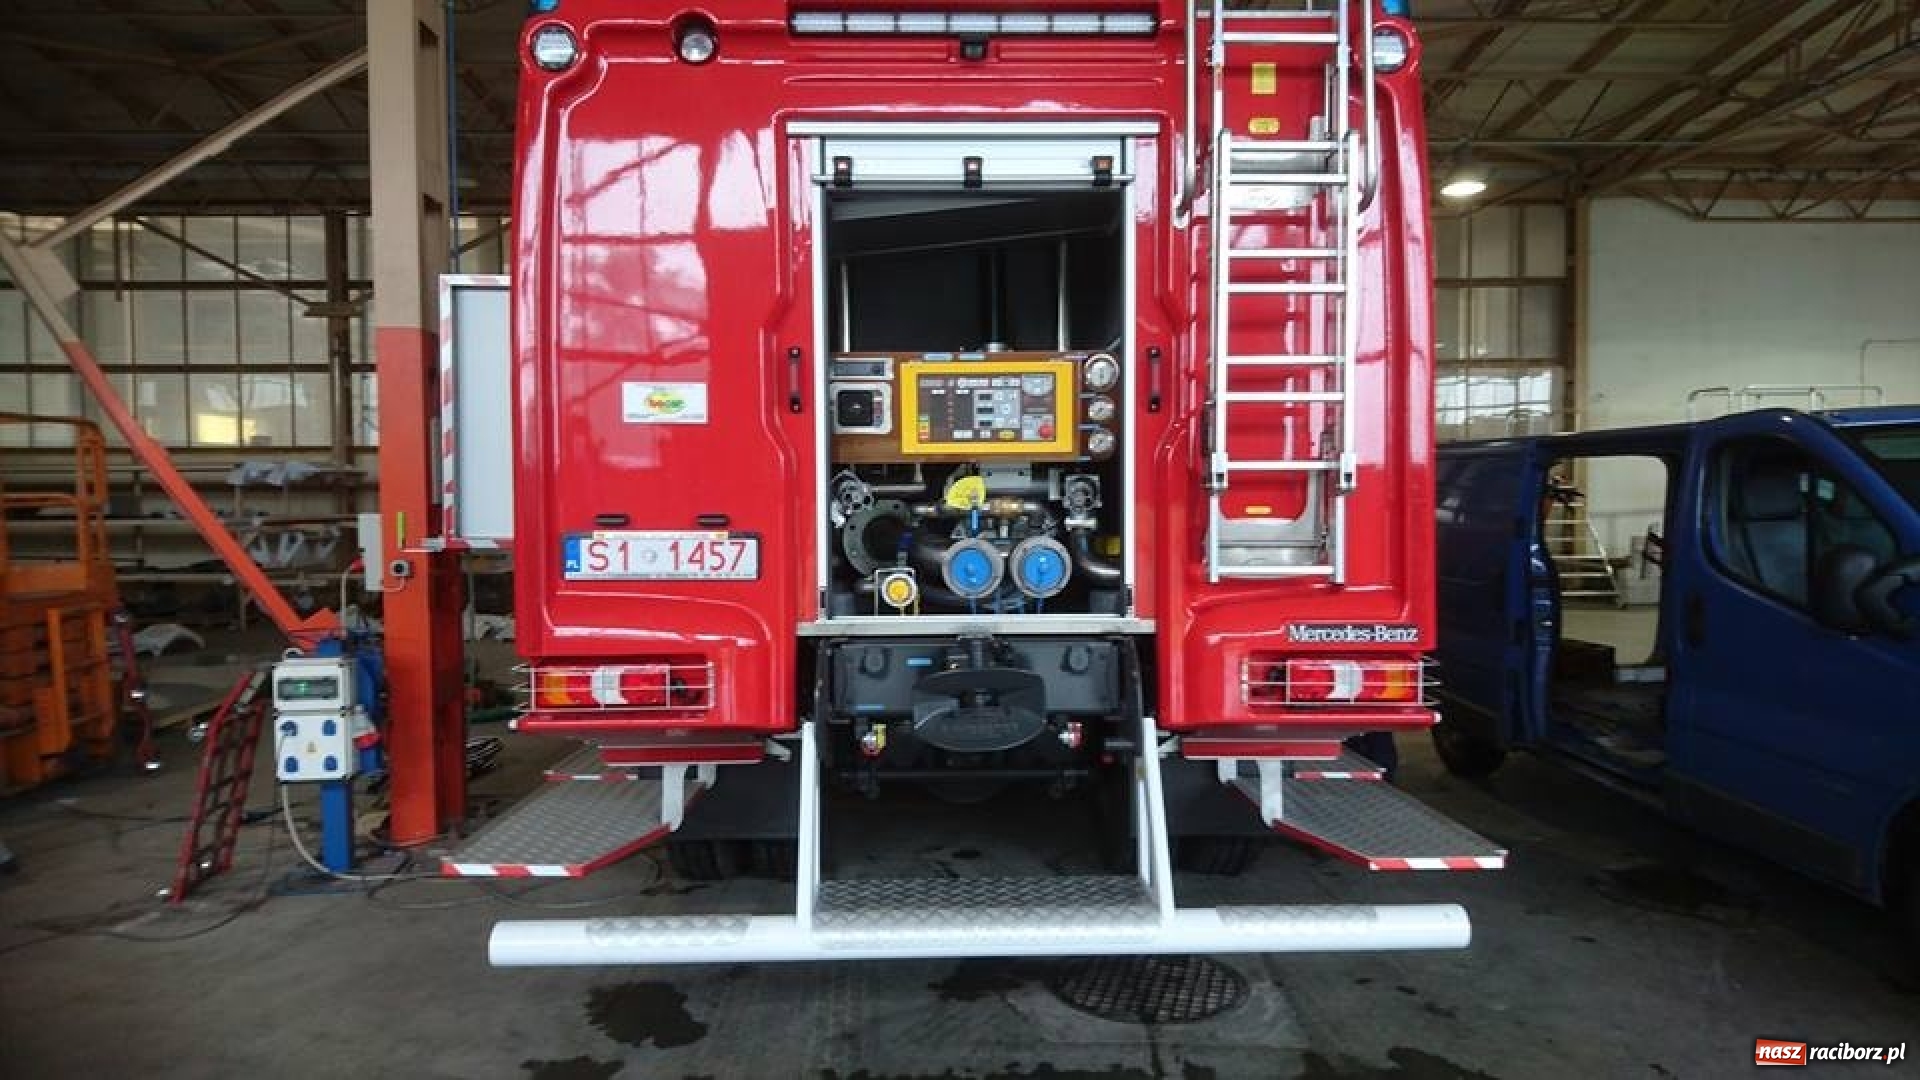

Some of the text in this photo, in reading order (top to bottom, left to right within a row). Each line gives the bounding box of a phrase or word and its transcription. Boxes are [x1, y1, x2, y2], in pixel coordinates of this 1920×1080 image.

[587, 541, 747, 572] S1 1457
[1288, 624, 1419, 643] Mercedes-Benz
